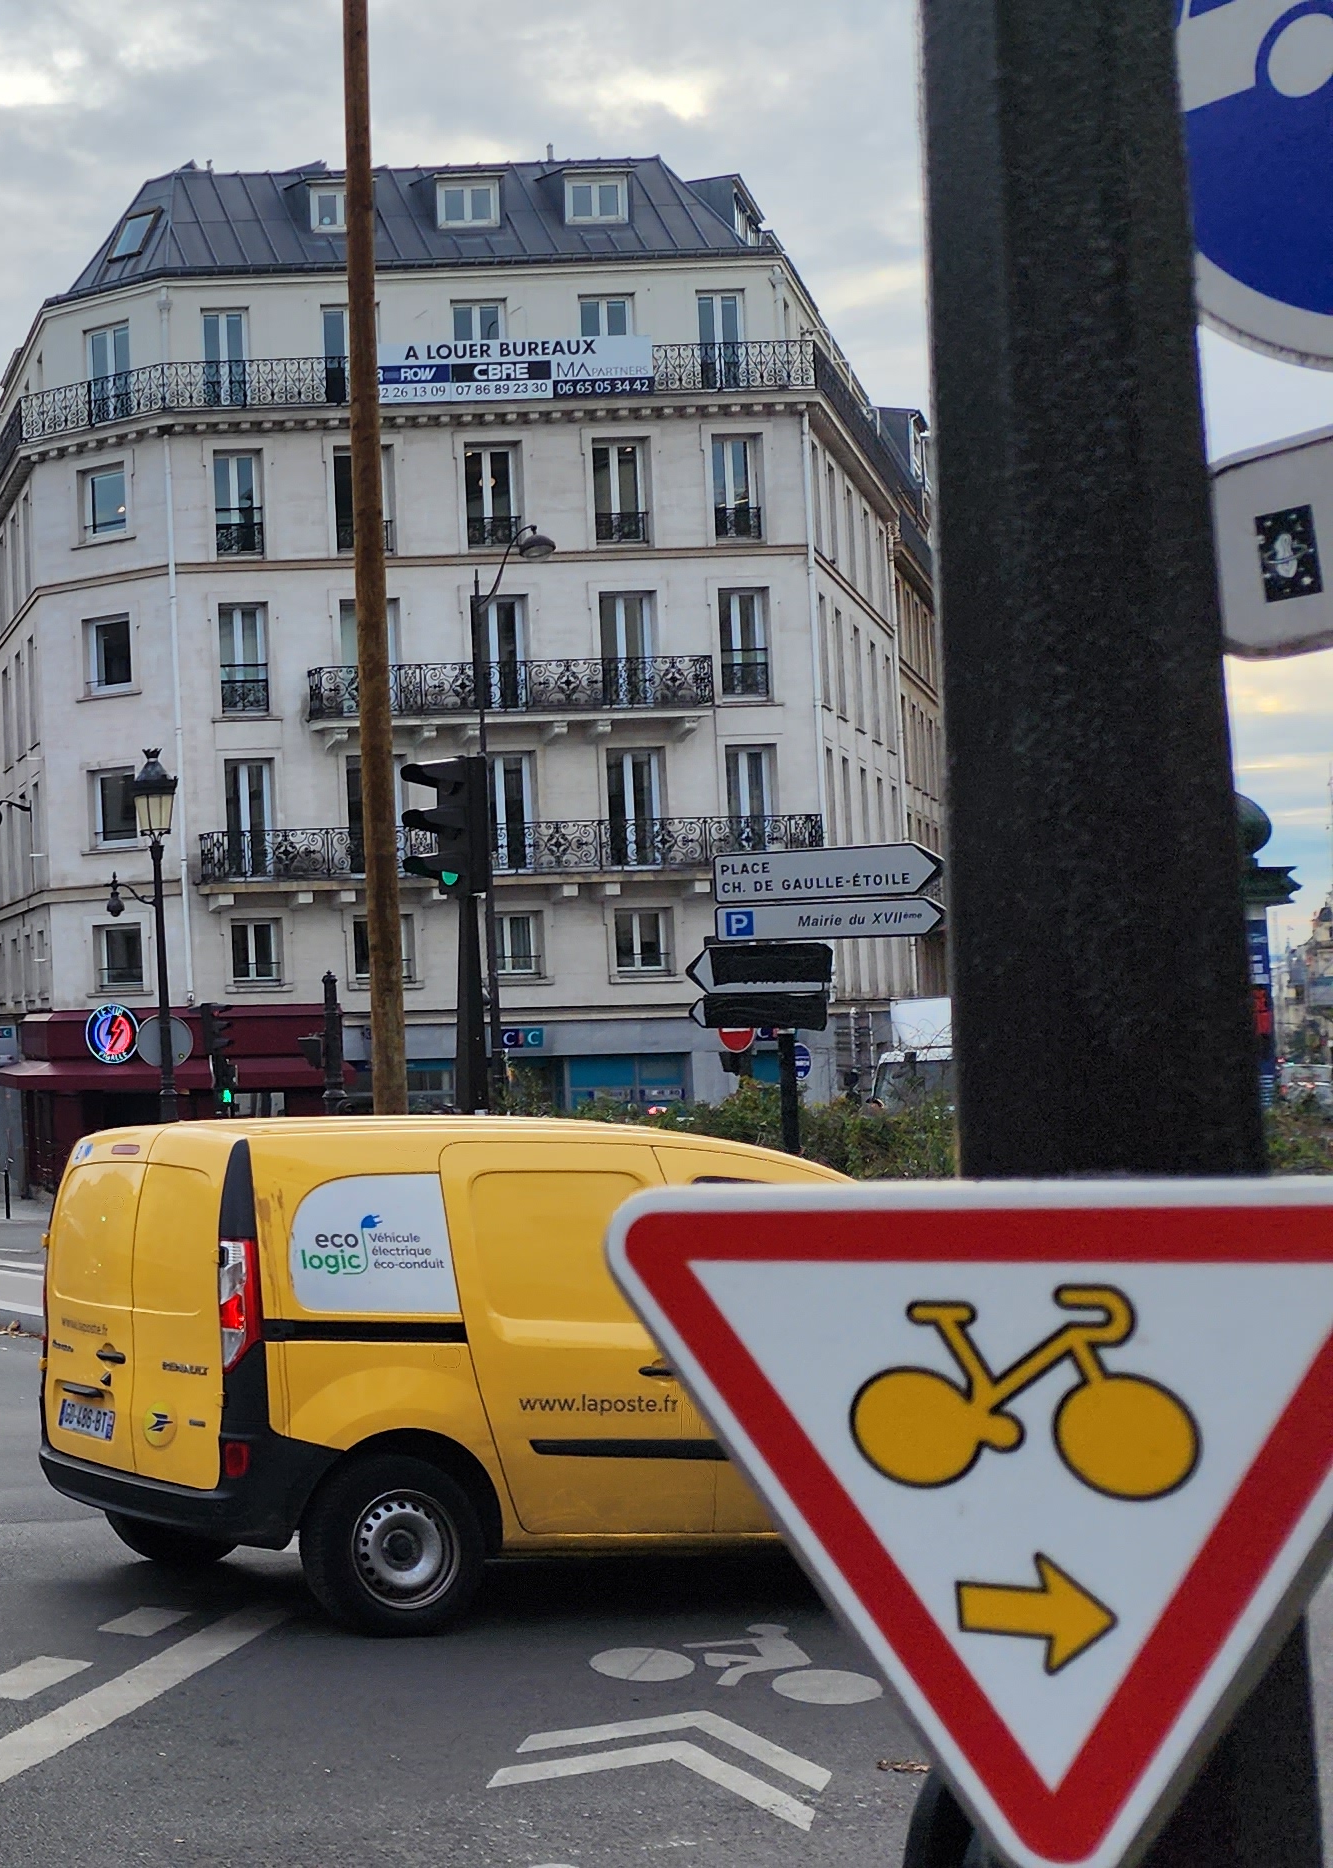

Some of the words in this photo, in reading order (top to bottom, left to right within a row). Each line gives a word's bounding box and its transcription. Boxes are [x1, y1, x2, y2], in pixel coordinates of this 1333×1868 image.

[405, 346, 419, 360] A
[427, 343, 491, 360] LOUER
[500, 339, 596, 358] BUREAUX
[401, 367, 436, 381] ROW
[473, 363, 529, 380] CBRE
[393, 387, 408, 397] 26
[413, 386, 427, 396] 13
[431, 386, 446, 396] 09
[456, 385, 471, 395] 07
[475, 385, 490, 395] 86
[494, 384, 509, 394] 89
[513, 383, 528, 393] 23
[532, 382, 547, 392] 30
[558, 383, 573, 394] 06
[576, 382, 592, 393] 65
[595, 382, 611, 393] 05
[614, 381, 631, 392] 34
[633, 380, 649, 391] 42
[721, 862, 770, 876] PLACE
[722, 881, 746, 894] CH.
[754, 880, 774, 892] DE
[782, 872, 910, 890] GAULLE-ÉTOILE
[798, 914, 842, 928] Mairie
[849, 913, 866, 925] du
[872, 911, 923, 925] XVIIème
[503, 1031, 540, 1046] CIC
[315, 1233, 359, 1249] eco
[369, 1232, 420, 1243] Véhicule
[372, 1245, 431, 1259] électrique
[301, 1249, 361, 1275] logic
[374, 1258, 444, 1269] éco-conduit
[519, 1394, 678, 1416] www.laposte.fr
